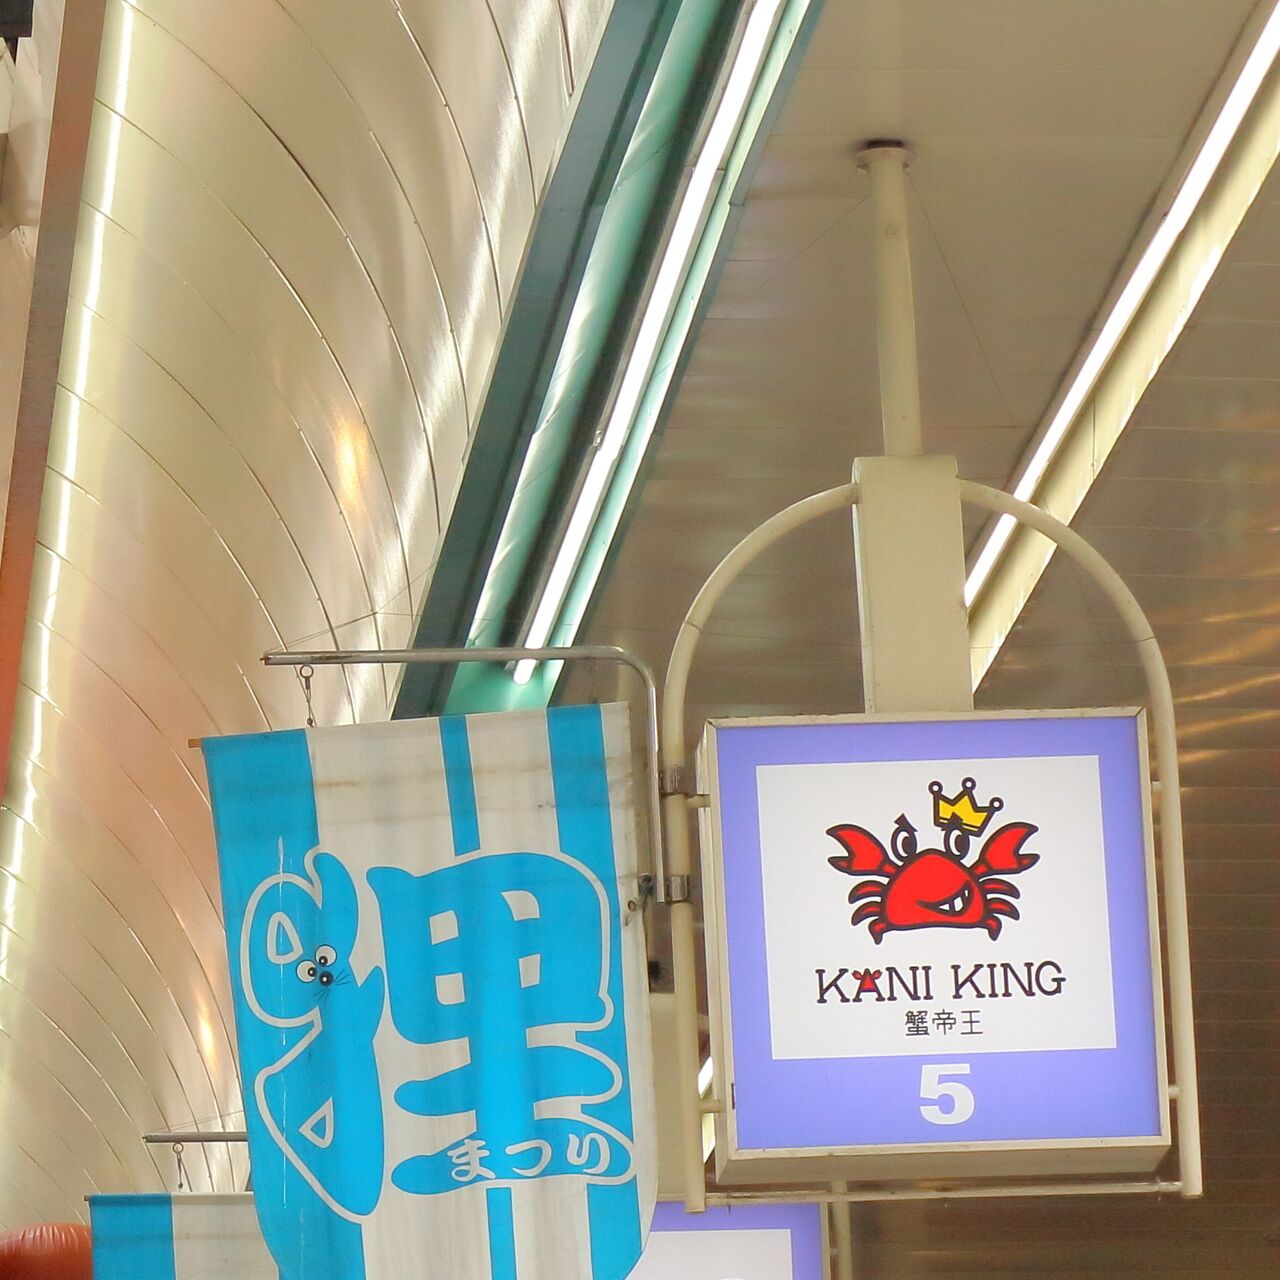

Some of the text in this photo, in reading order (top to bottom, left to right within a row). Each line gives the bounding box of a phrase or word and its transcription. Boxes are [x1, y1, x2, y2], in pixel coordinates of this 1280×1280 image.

[815, 961, 1067, 1003] KANI KING
[905, 1009, 983, 1036] 蟹帝王
[920, 1063, 975, 1125] 5
[448, 1132, 610, 1182] まつり
